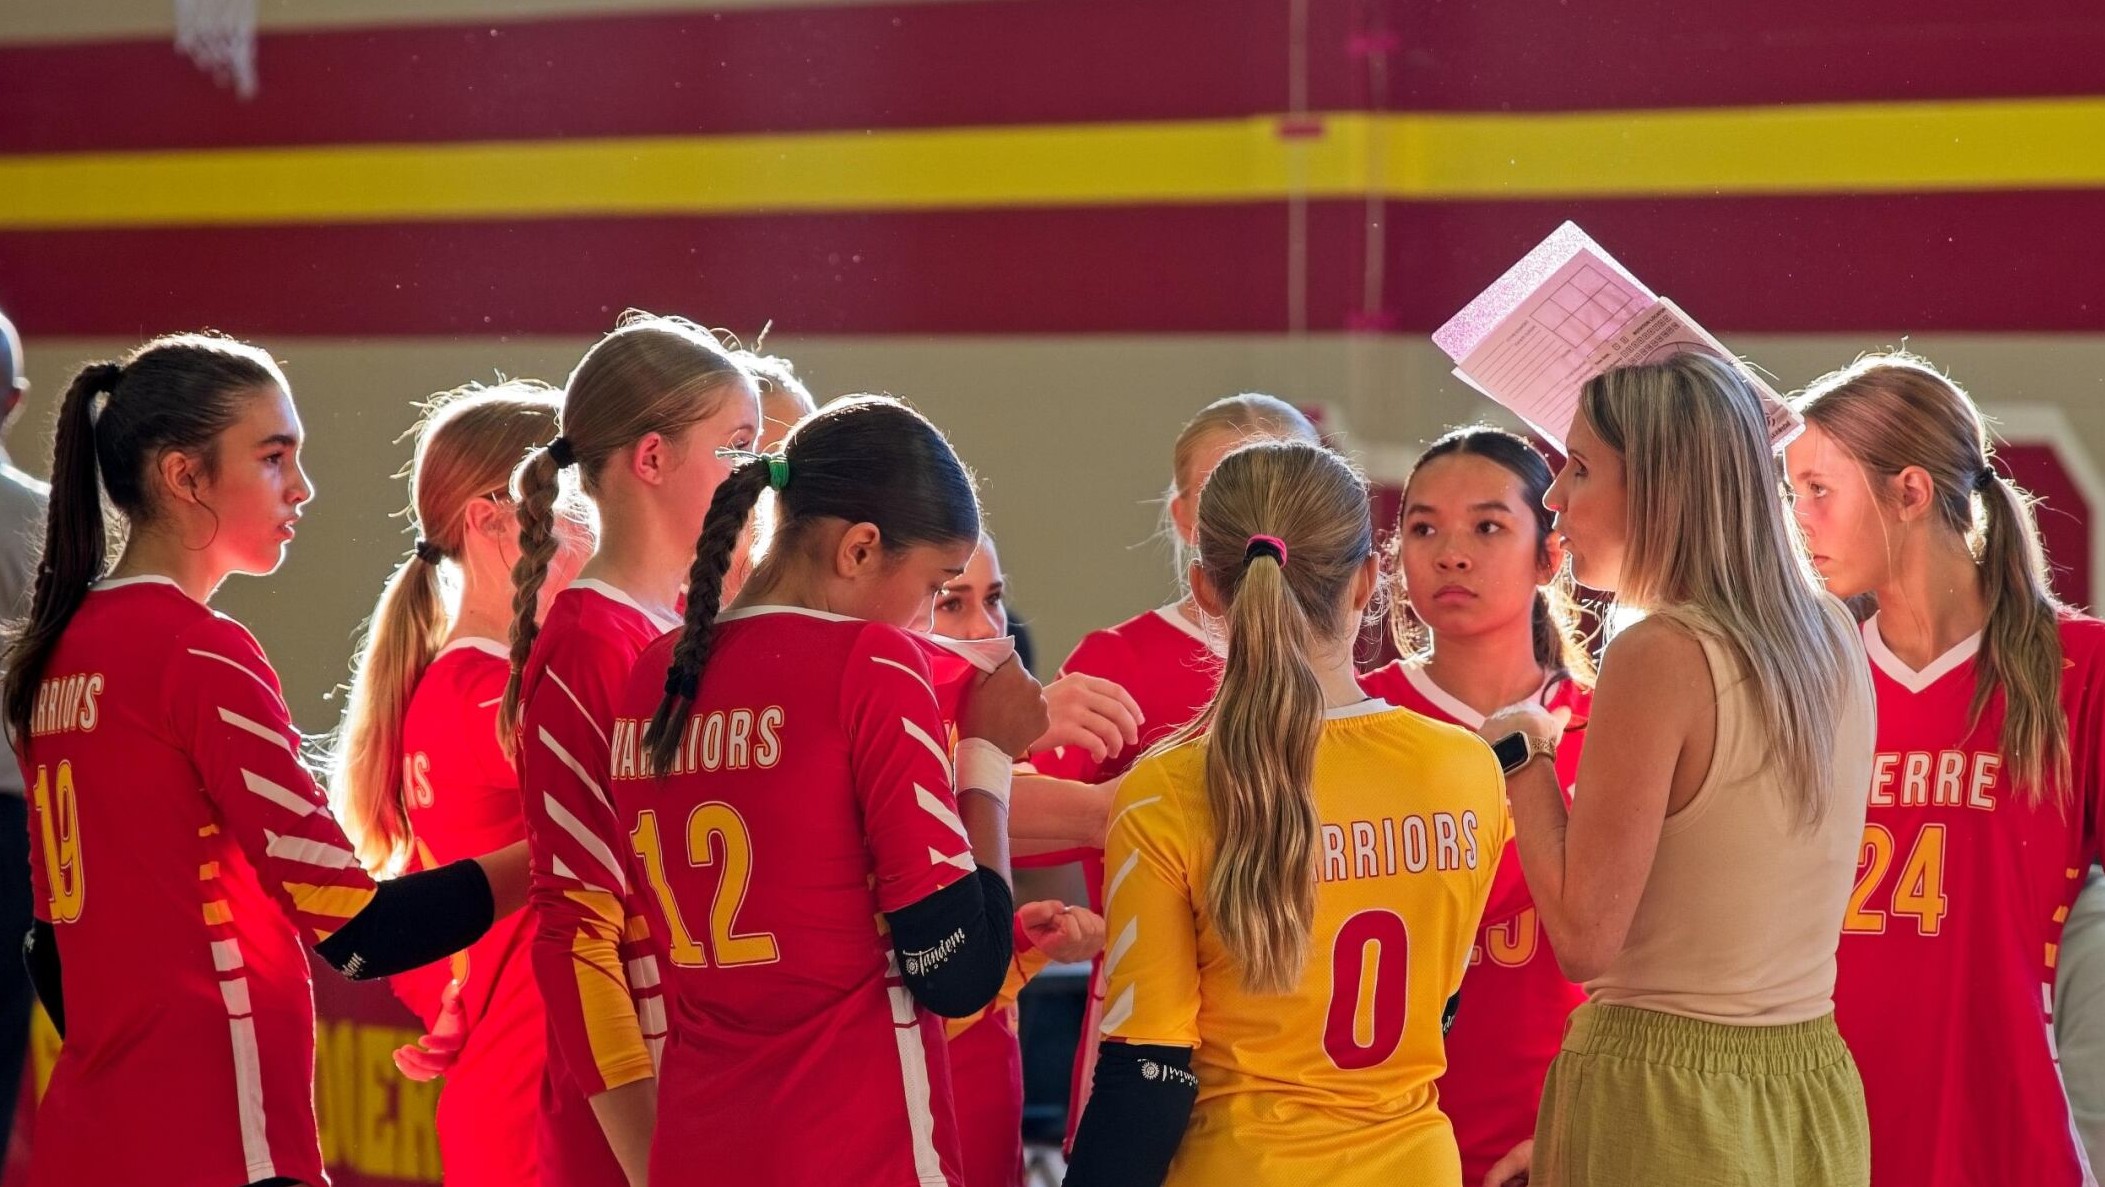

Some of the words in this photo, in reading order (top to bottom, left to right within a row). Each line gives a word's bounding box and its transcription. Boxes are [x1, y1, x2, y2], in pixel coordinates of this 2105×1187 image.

[31, 673, 104, 737] RRIORS
[610, 706, 784, 780] WARIORS
[1867, 750, 2002, 811] ERRE
[33, 759, 84, 923] 19
[629, 801, 780, 968] 12
[1313, 810, 1478, 882] RRIORS
[1841, 823, 1948, 936] 24
[1322, 908, 1409, 1070] 0
